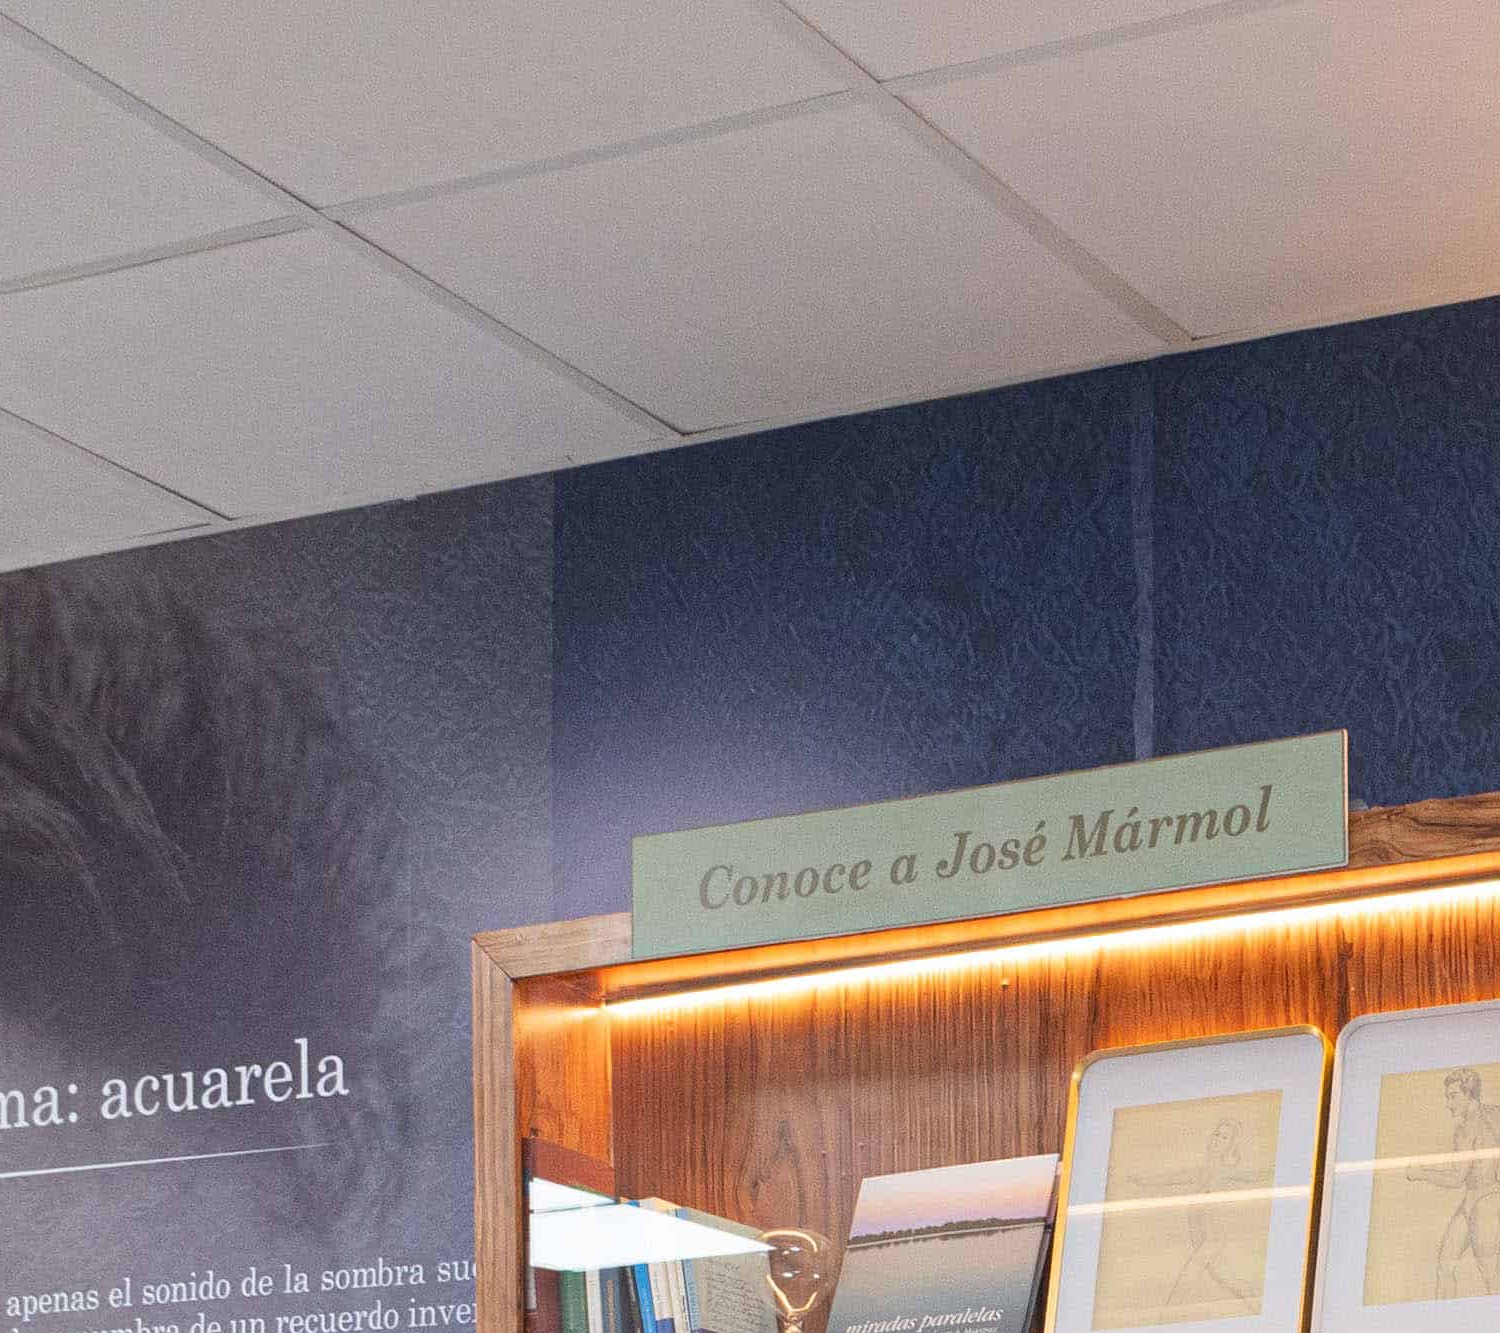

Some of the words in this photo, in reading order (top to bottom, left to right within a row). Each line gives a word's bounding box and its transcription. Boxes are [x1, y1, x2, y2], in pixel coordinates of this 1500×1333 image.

[698, 856, 873, 911] Conoce
[889, 852, 919, 887] a
[934, 818, 1048, 881] José
[1060, 783, 1274, 863] Mármol
[100, 1036, 351, 1121] acuarela
[5, 1289, 100, 1323] apenas
[107, 1275, 133, 1310] el
[141, 1268, 232, 1307] sonido
[240, 1265, 274, 1299] de
[282, 1262, 310, 1295] la
[320, 1256, 426, 1292] sombra
[916, 1305, 1004, 1333] paralelas
